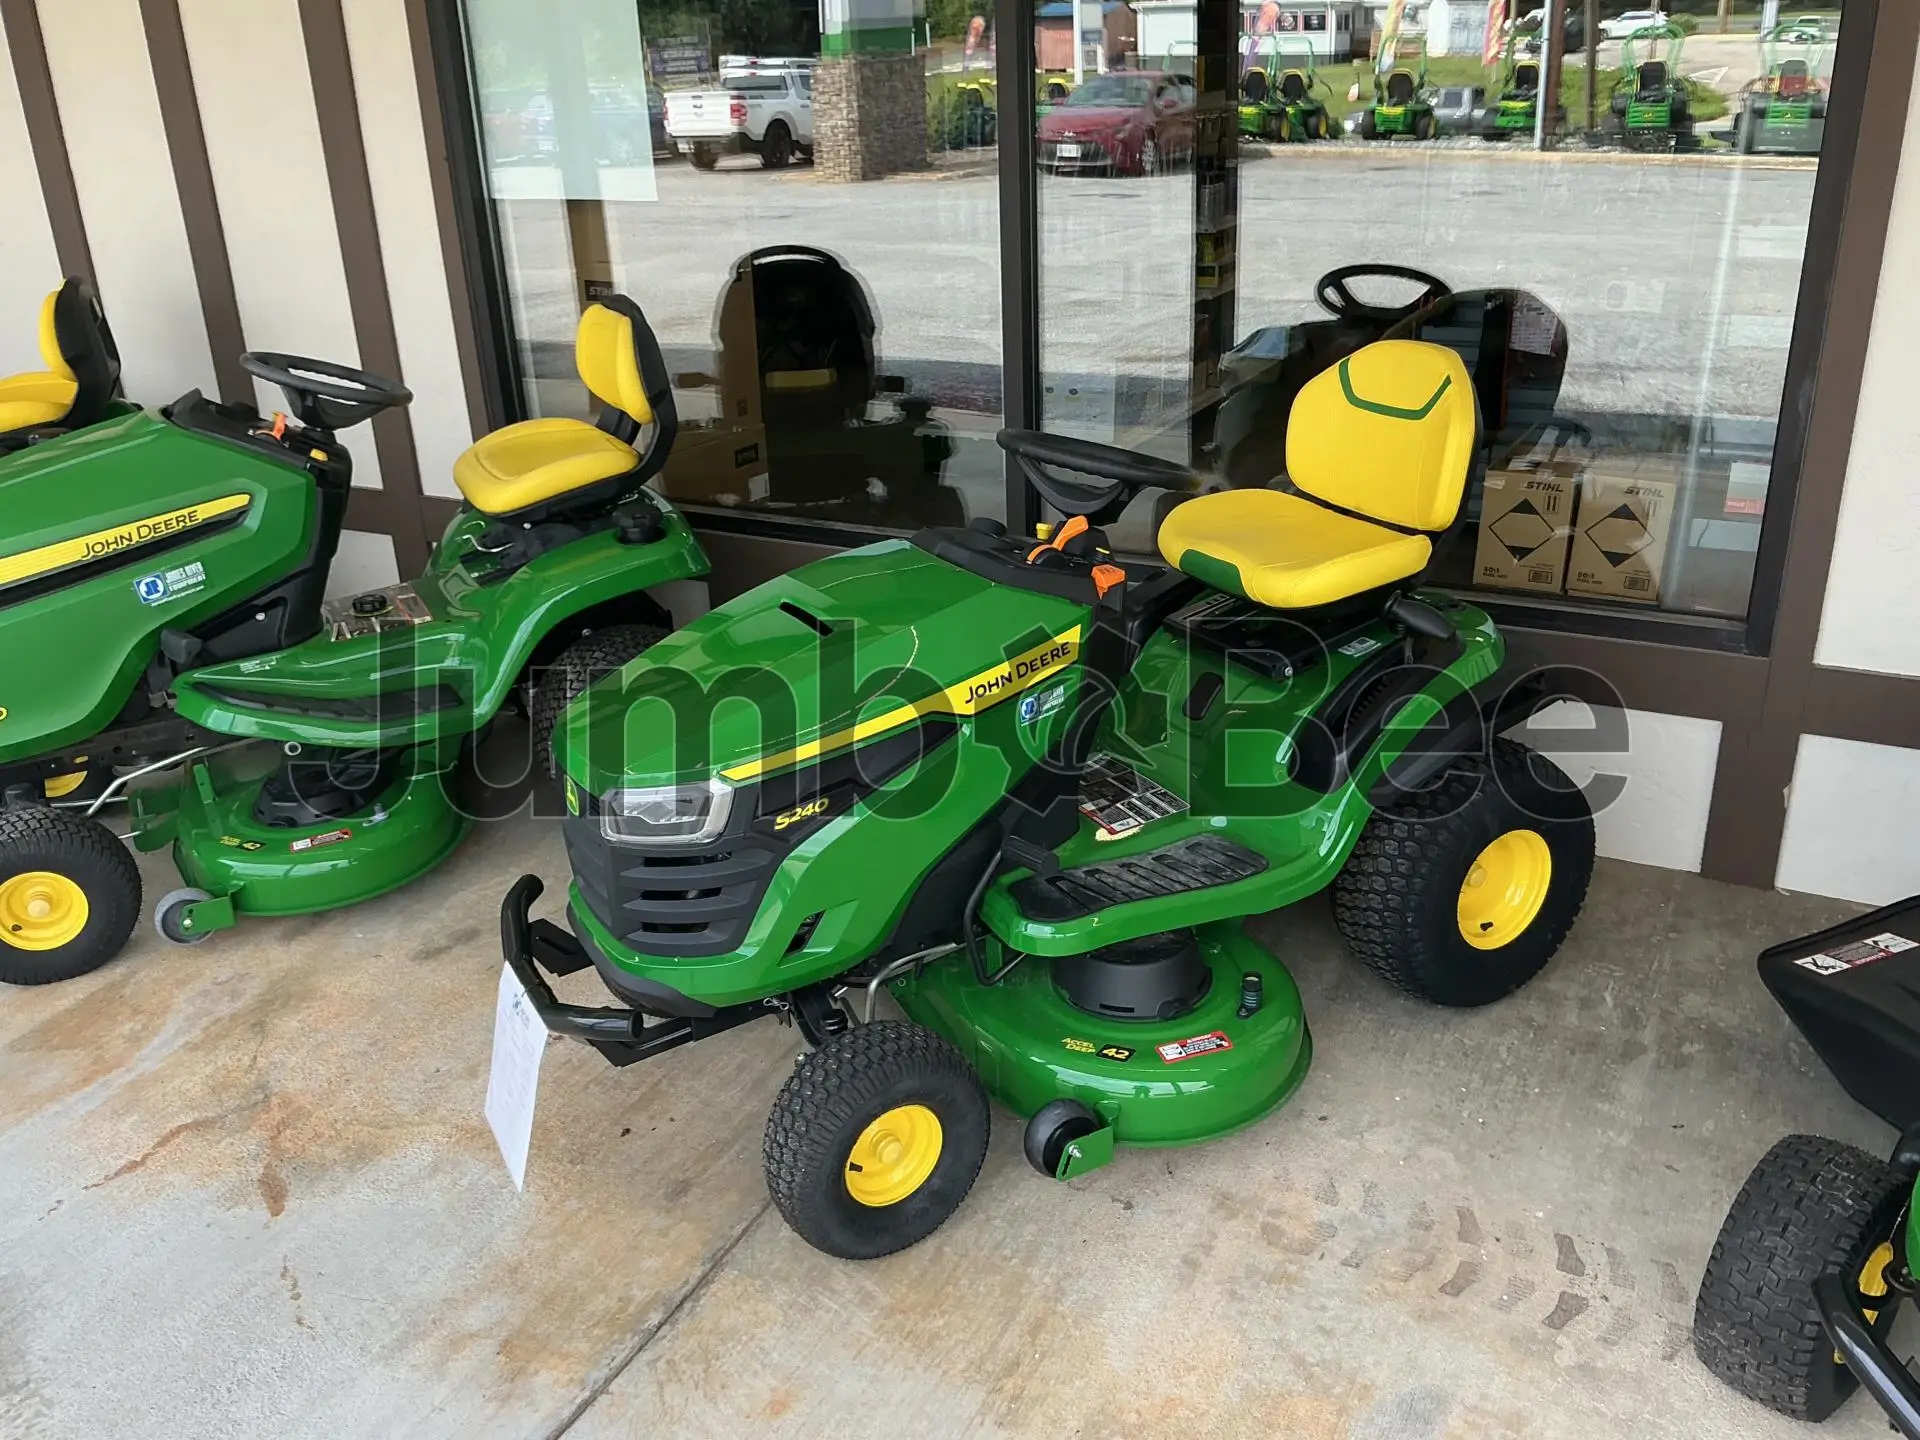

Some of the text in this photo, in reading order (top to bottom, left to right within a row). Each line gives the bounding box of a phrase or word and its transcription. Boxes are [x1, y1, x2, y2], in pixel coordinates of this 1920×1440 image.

[1525, 481, 1564, 493] STIHL
[1624, 486, 1665, 498] STIHL
[81, 510, 200, 559] JOHN DEERE
[965, 671, 1013, 704] JOHN
[1015, 642, 1071, 679] DEERE
[774, 798, 829, 831] S240
[1061, 1037, 1095, 1048] ACCEL
[1065, 1043, 1097, 1054] DEEP
[1102, 1047, 1130, 1060] 42
